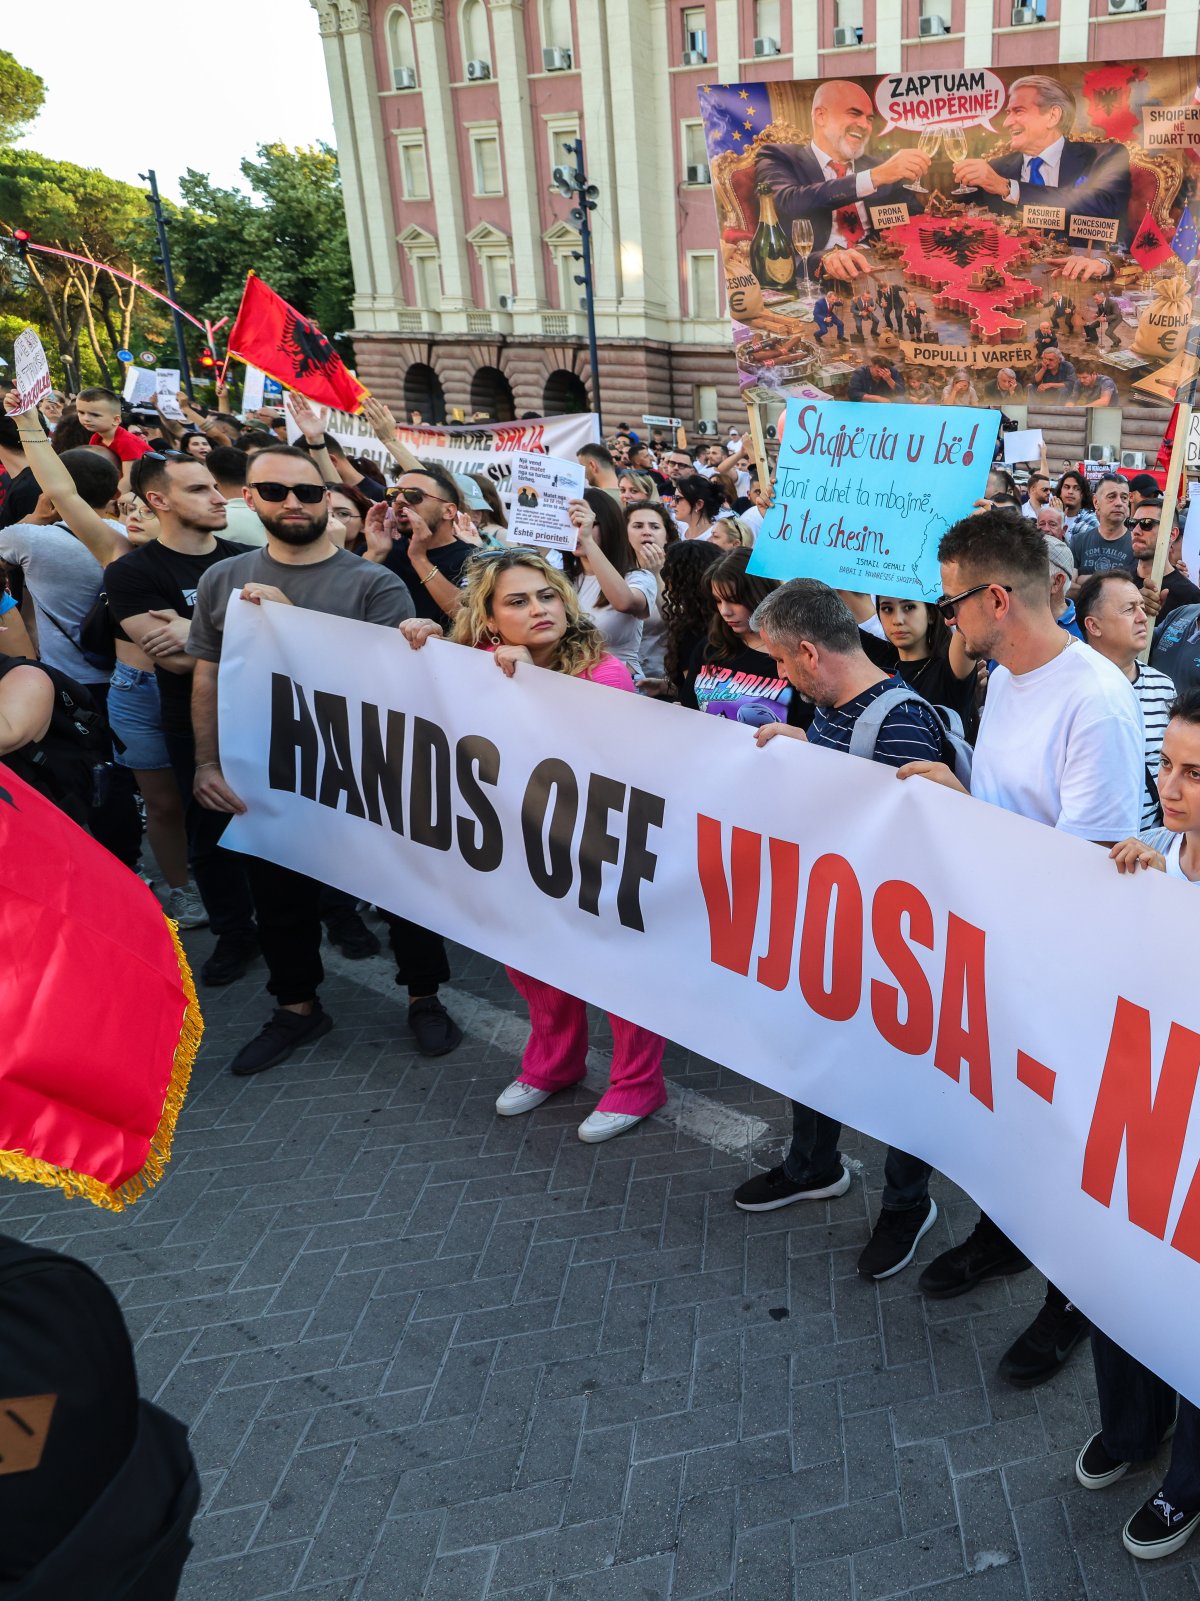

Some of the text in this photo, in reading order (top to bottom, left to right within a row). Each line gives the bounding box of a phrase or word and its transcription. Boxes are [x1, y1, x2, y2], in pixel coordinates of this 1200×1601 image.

[889, 72, 985, 99] ZAPTUAM
[888, 89, 999, 123] SHQIPËRINË!
[1173, 122, 1185, 132] NË
[1149, 133, 1184, 145] DUART
[877, 207, 902, 217] PRONA
[877, 215, 906, 226] PUBLIKE
[1026, 217, 1061, 227] NATYRORE
[1072, 218, 1116, 231] KONCESIONE
[1077, 227, 1114, 239] MONOPOLE
[913, 347, 1033, 362] POPULLI I VARFËR
[449, 430, 494, 452] MORE
[906, 434, 925, 463] u
[519, 457, 528, 465] Një
[779, 466, 811, 499] Tani
[815, 477, 852, 504] duhet
[856, 484, 870, 506] ta
[768, 502, 793, 541] Jo
[800, 508, 822, 545] ta
[513, 527, 570, 544] Është prioriteti.
[856, 557, 906, 572] ISMAIL QEMALI
[268, 672, 504, 873] HANDS
[520, 757, 666, 934] OFF
[696, 812, 994, 1113] VJOSA
